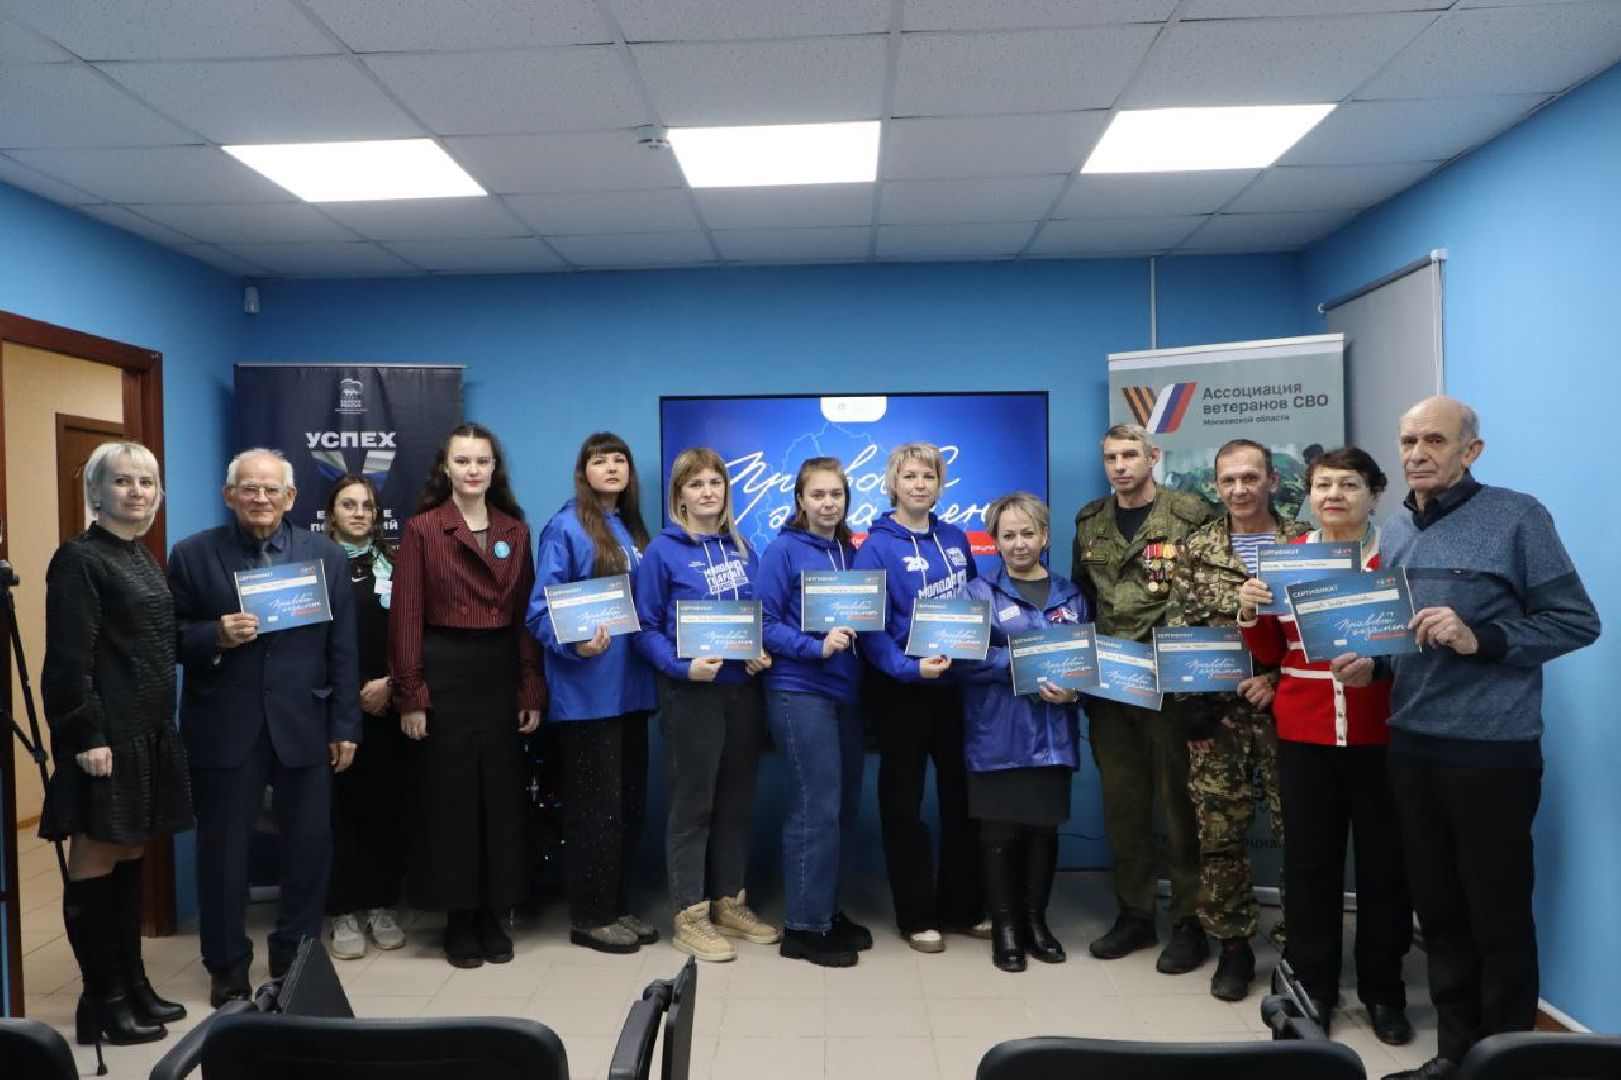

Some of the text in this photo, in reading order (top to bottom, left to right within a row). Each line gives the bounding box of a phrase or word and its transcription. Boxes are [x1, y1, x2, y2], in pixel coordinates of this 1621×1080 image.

[1203, 384, 1302, 400] Ассоциация
[1203, 395, 1329, 415] ветеранов СВО
[1203, 415, 1290, 425] Московской области
[305, 432, 397, 448] УСПЕХ
